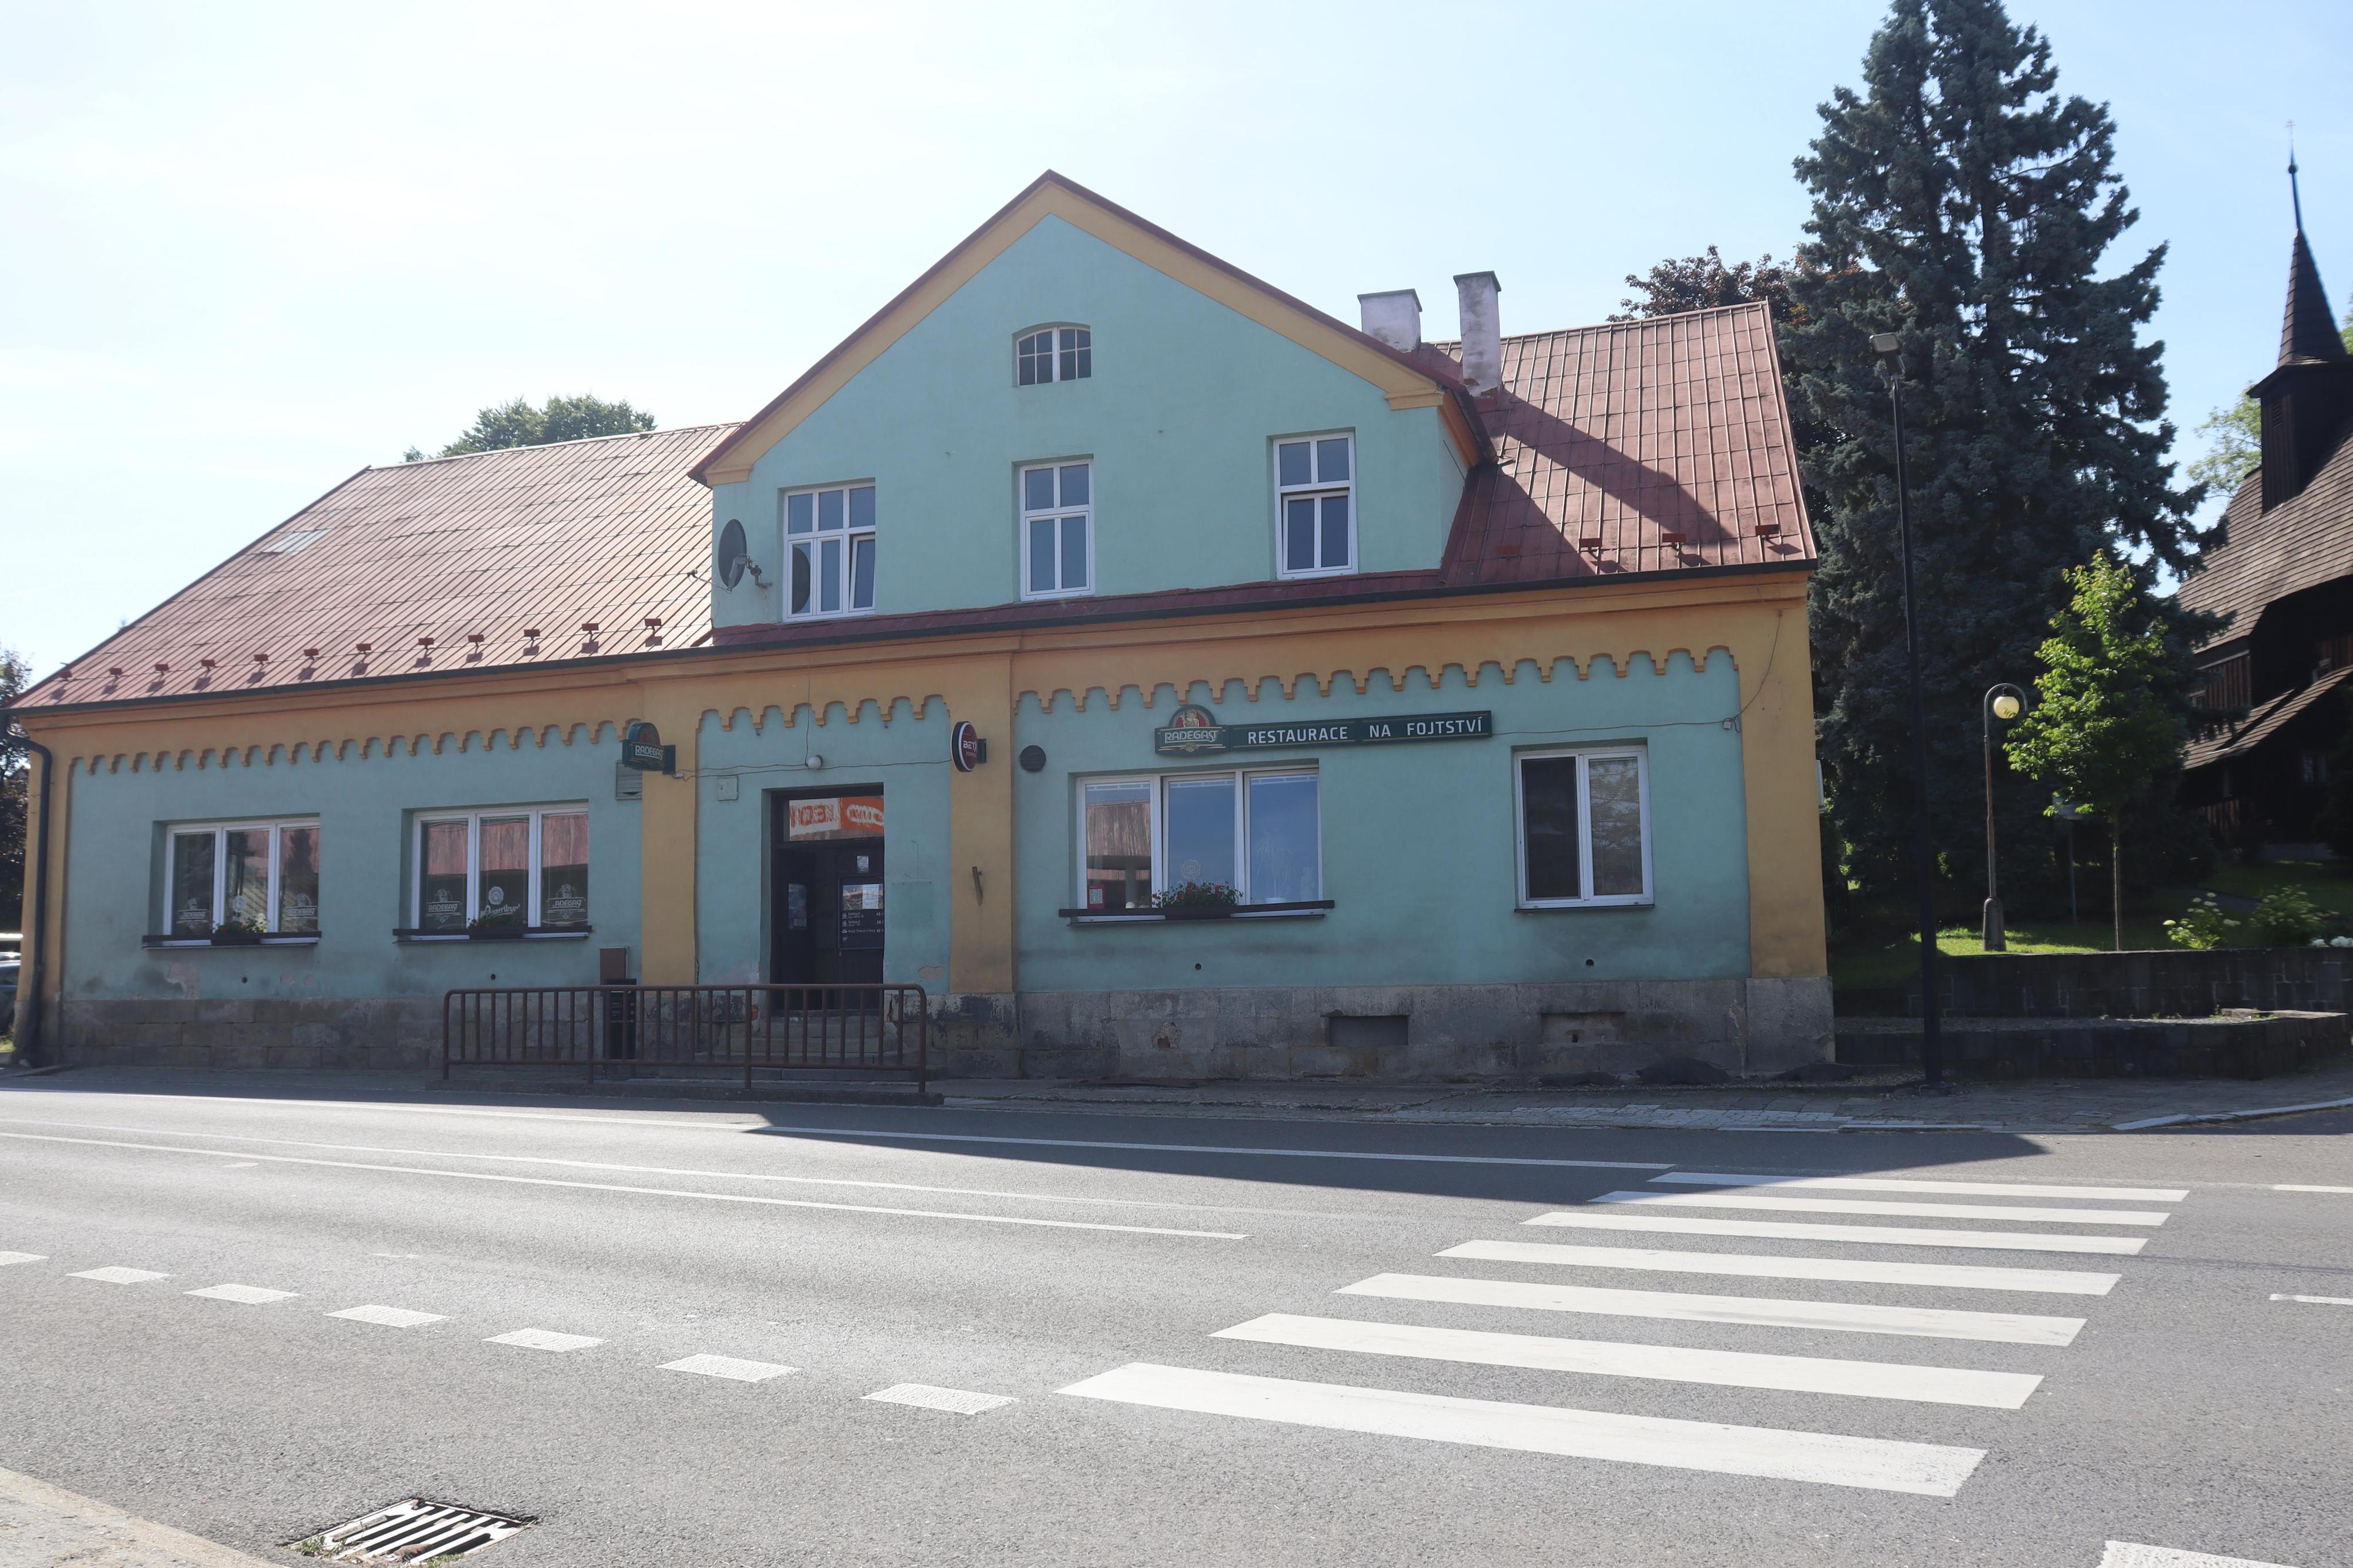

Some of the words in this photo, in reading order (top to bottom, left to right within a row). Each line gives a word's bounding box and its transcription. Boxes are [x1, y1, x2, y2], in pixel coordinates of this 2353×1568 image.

[1164, 730, 1219, 743] RADEGAST
[1248, 726, 1348, 744] RESTAURACE
[1369, 724, 1391, 738] NA
[1407, 716, 1482, 735] FOJTSTVÍ
